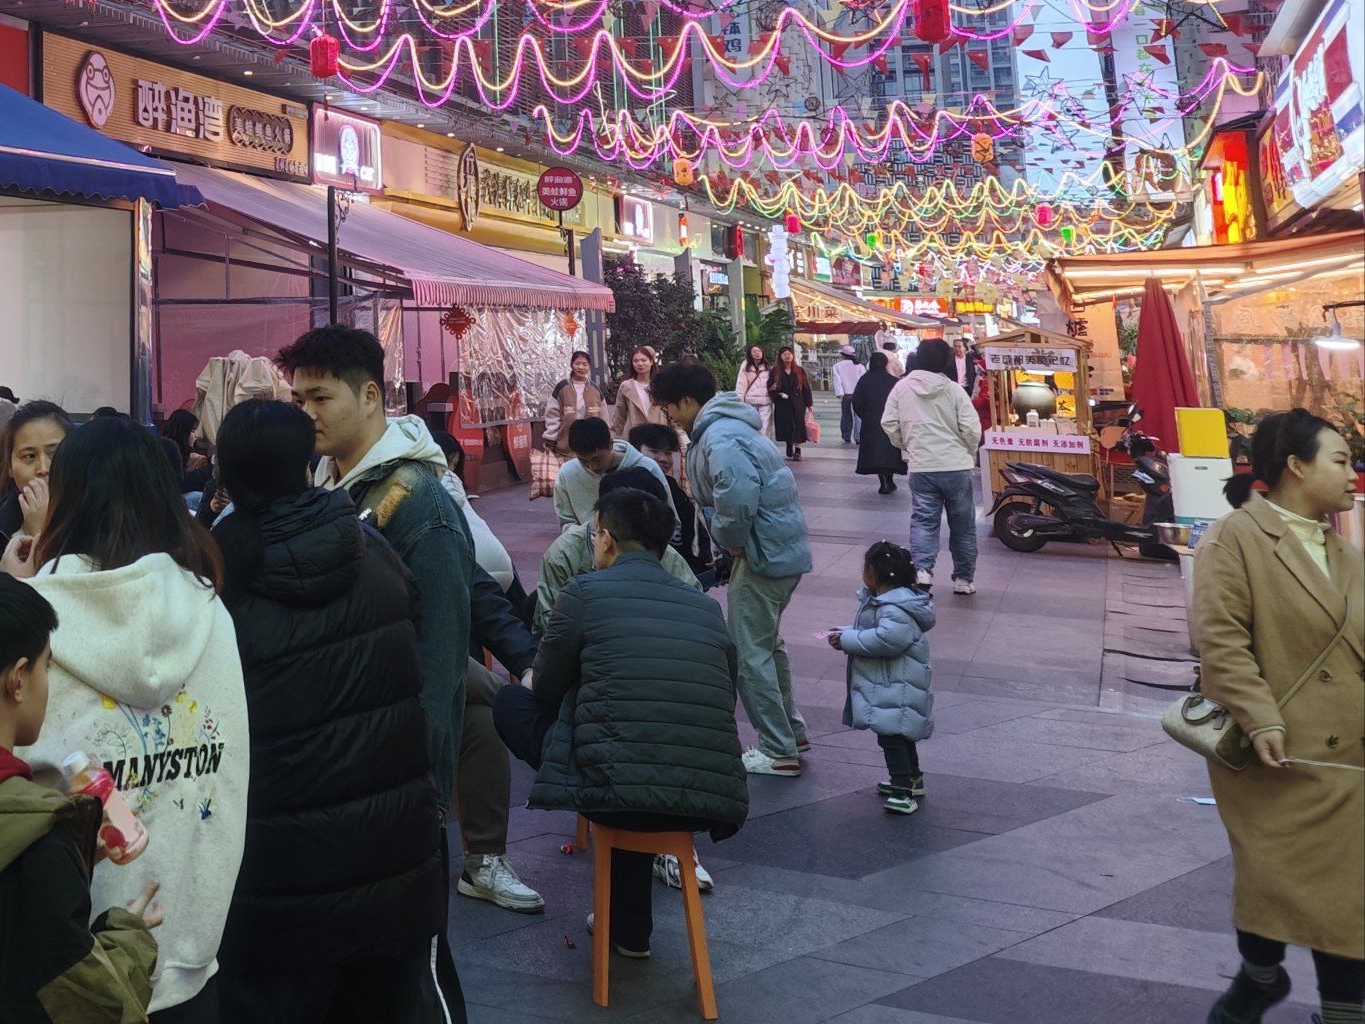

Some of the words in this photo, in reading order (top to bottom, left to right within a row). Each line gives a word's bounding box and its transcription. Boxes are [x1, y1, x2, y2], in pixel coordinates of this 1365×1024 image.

[135, 79, 224, 143] 醉渔湾
[550, 197, 569, 207] 火锅
[103, 742, 224, 791] MANYSTON
